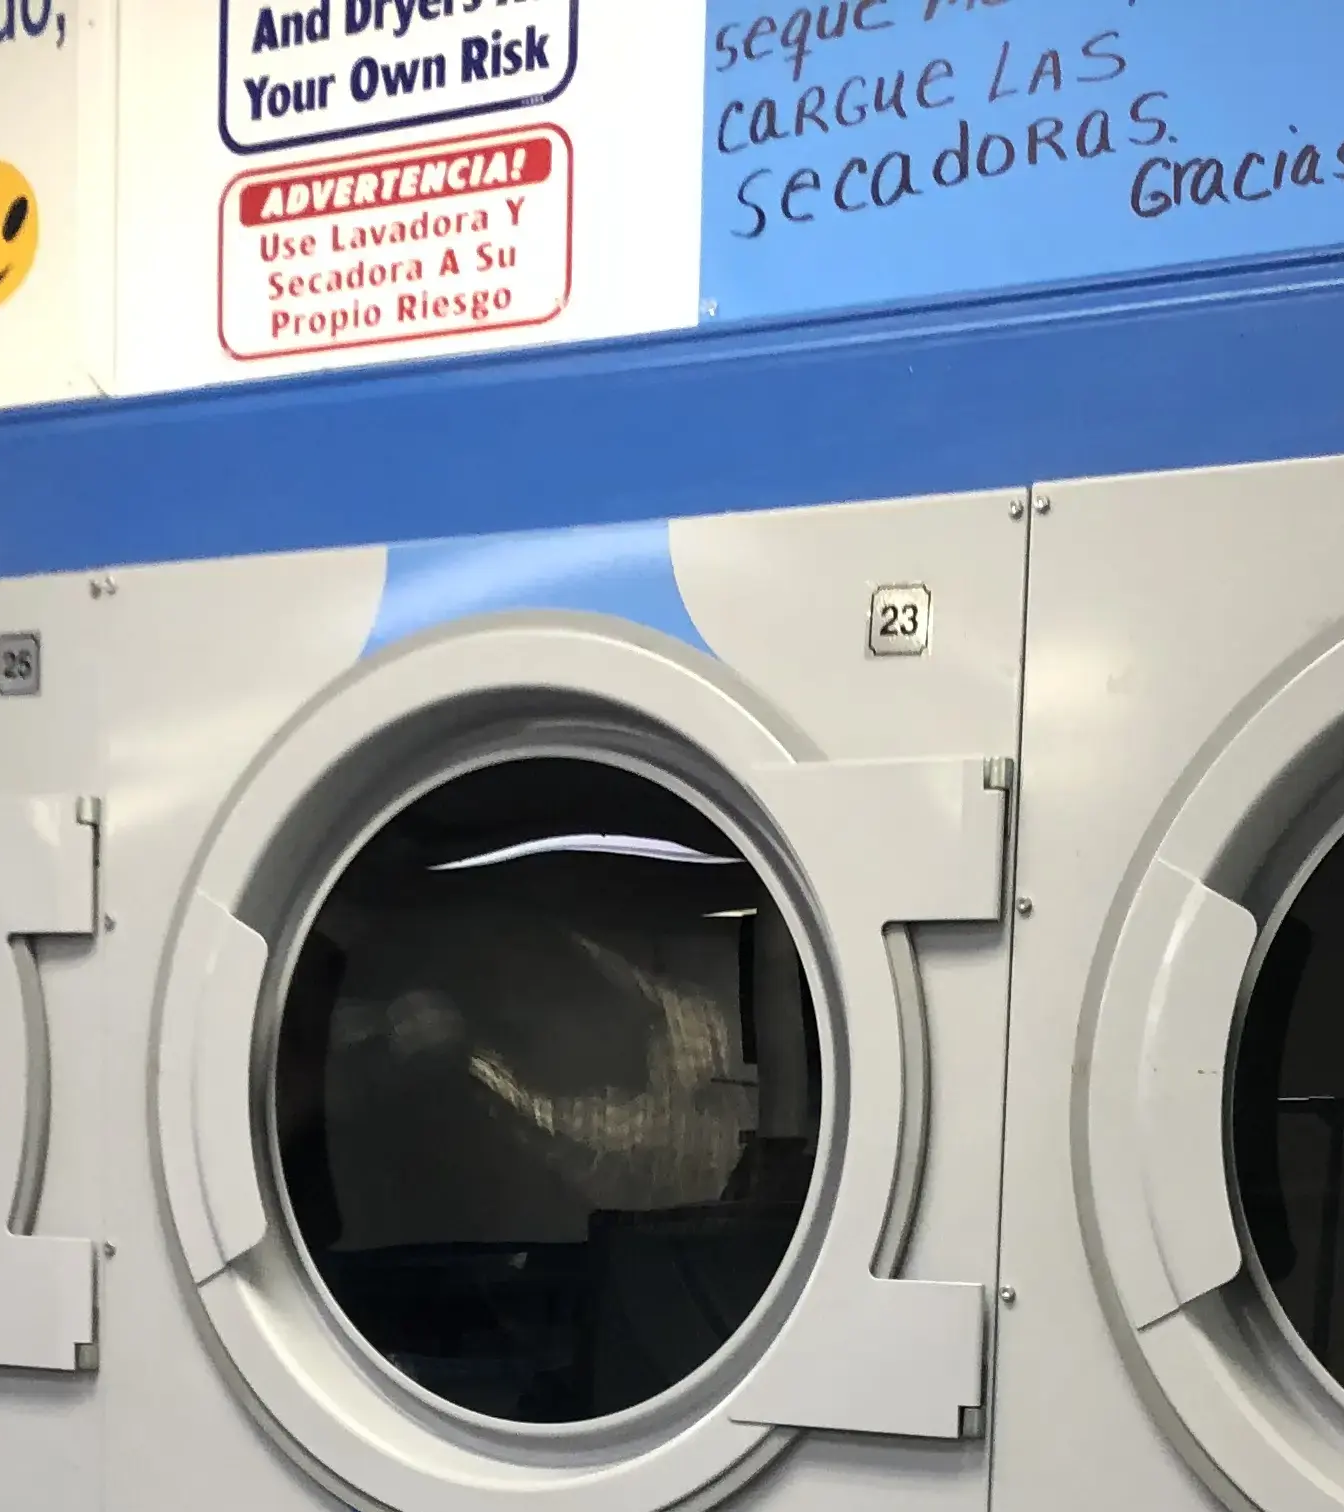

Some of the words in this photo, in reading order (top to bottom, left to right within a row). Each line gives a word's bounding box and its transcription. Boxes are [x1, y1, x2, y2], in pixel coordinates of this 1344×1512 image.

[251, 0, 331, 53] And
[243, 73, 336, 121] Your
[349, 54, 447, 102] Own
[461, 25, 550, 84] Risk
[988, 31, 1127, 103] LAS
[260, 149, 526, 220] ADVERTENCIA!
[259, 231, 317, 262] Use
[331, 206, 489, 252] Lavadora
[503, 198, 526, 227] Y
[268, 257, 424, 301] Secadora
[438, 248, 461, 276] A
[476, 242, 518, 271] Su
[270, 303, 382, 342] Propio
[397, 283, 513, 326] Riesgo
[880, 604, 918, 636] 23
